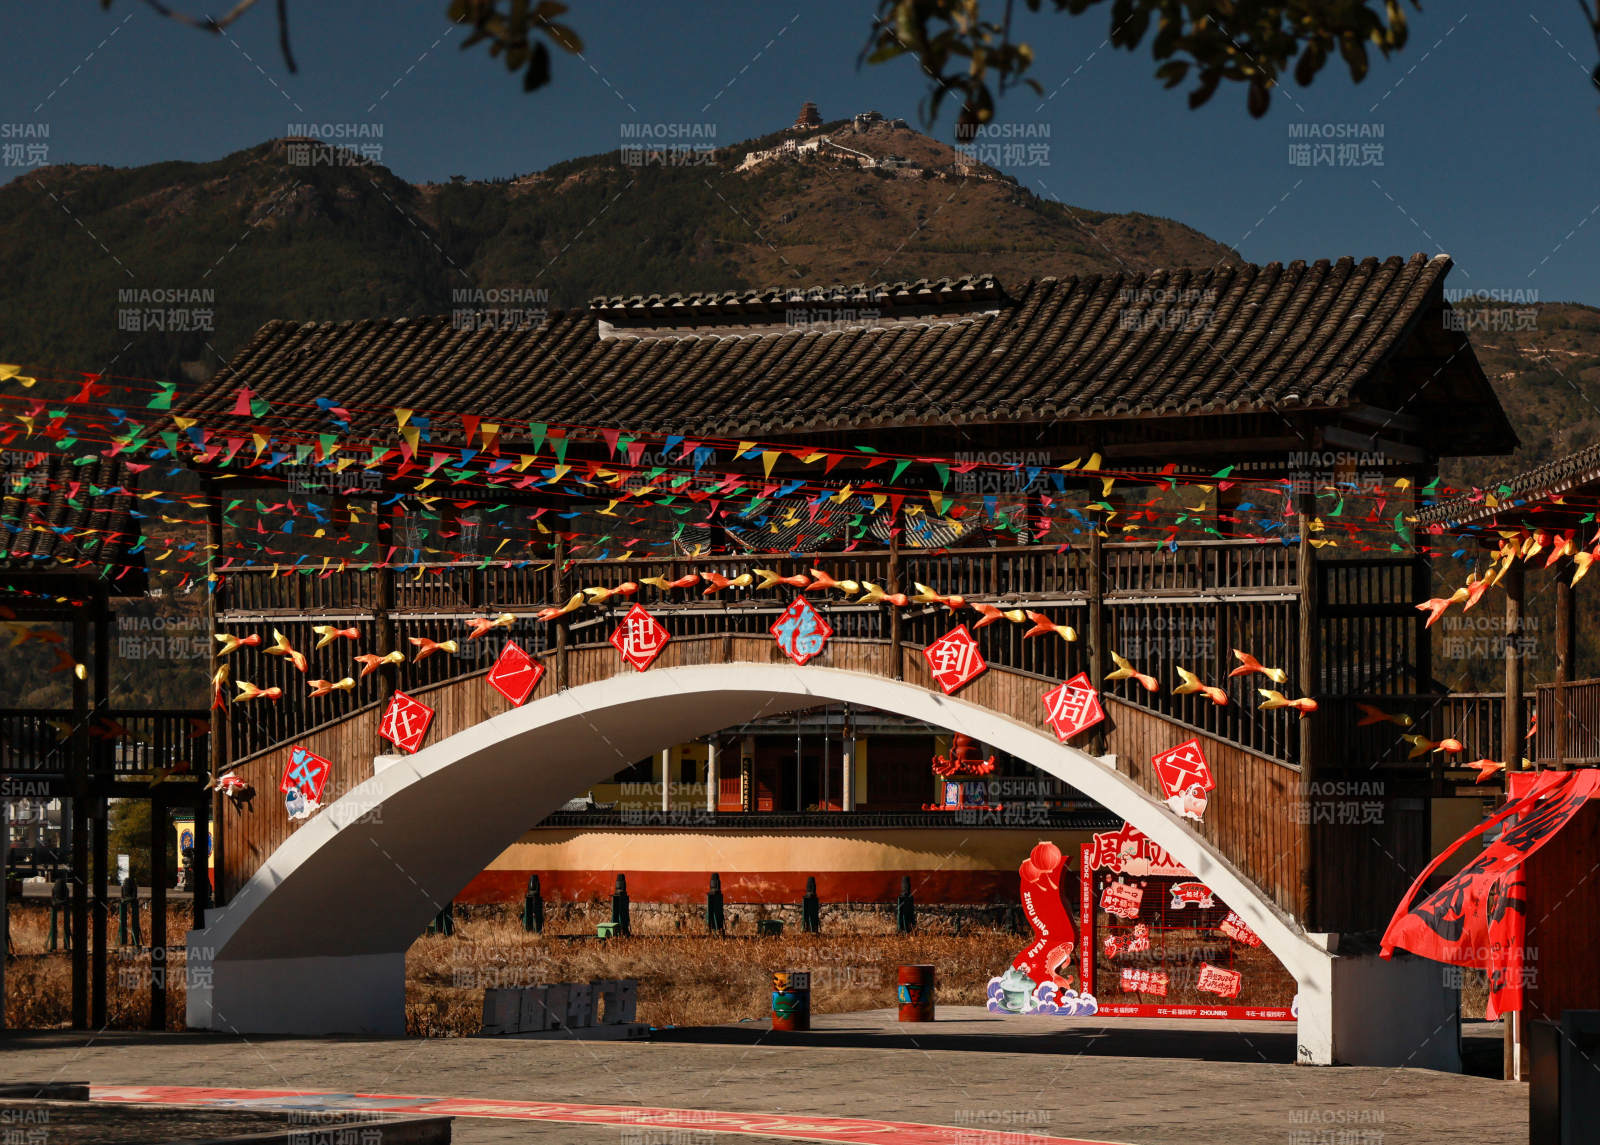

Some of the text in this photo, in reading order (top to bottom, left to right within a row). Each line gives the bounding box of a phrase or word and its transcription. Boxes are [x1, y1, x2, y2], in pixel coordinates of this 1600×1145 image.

[289, 750, 322, 798] 年
[384, 699, 422, 746] 在
[622, 617, 658, 660] 起
[777, 605, 823, 655] 福
[932, 639, 977, 682] 到
[1045, 684, 1097, 730] 周
[1165, 751, 1207, 792] 宁
[1024, 892, 1049, 958] ZHOU NING YEAR
